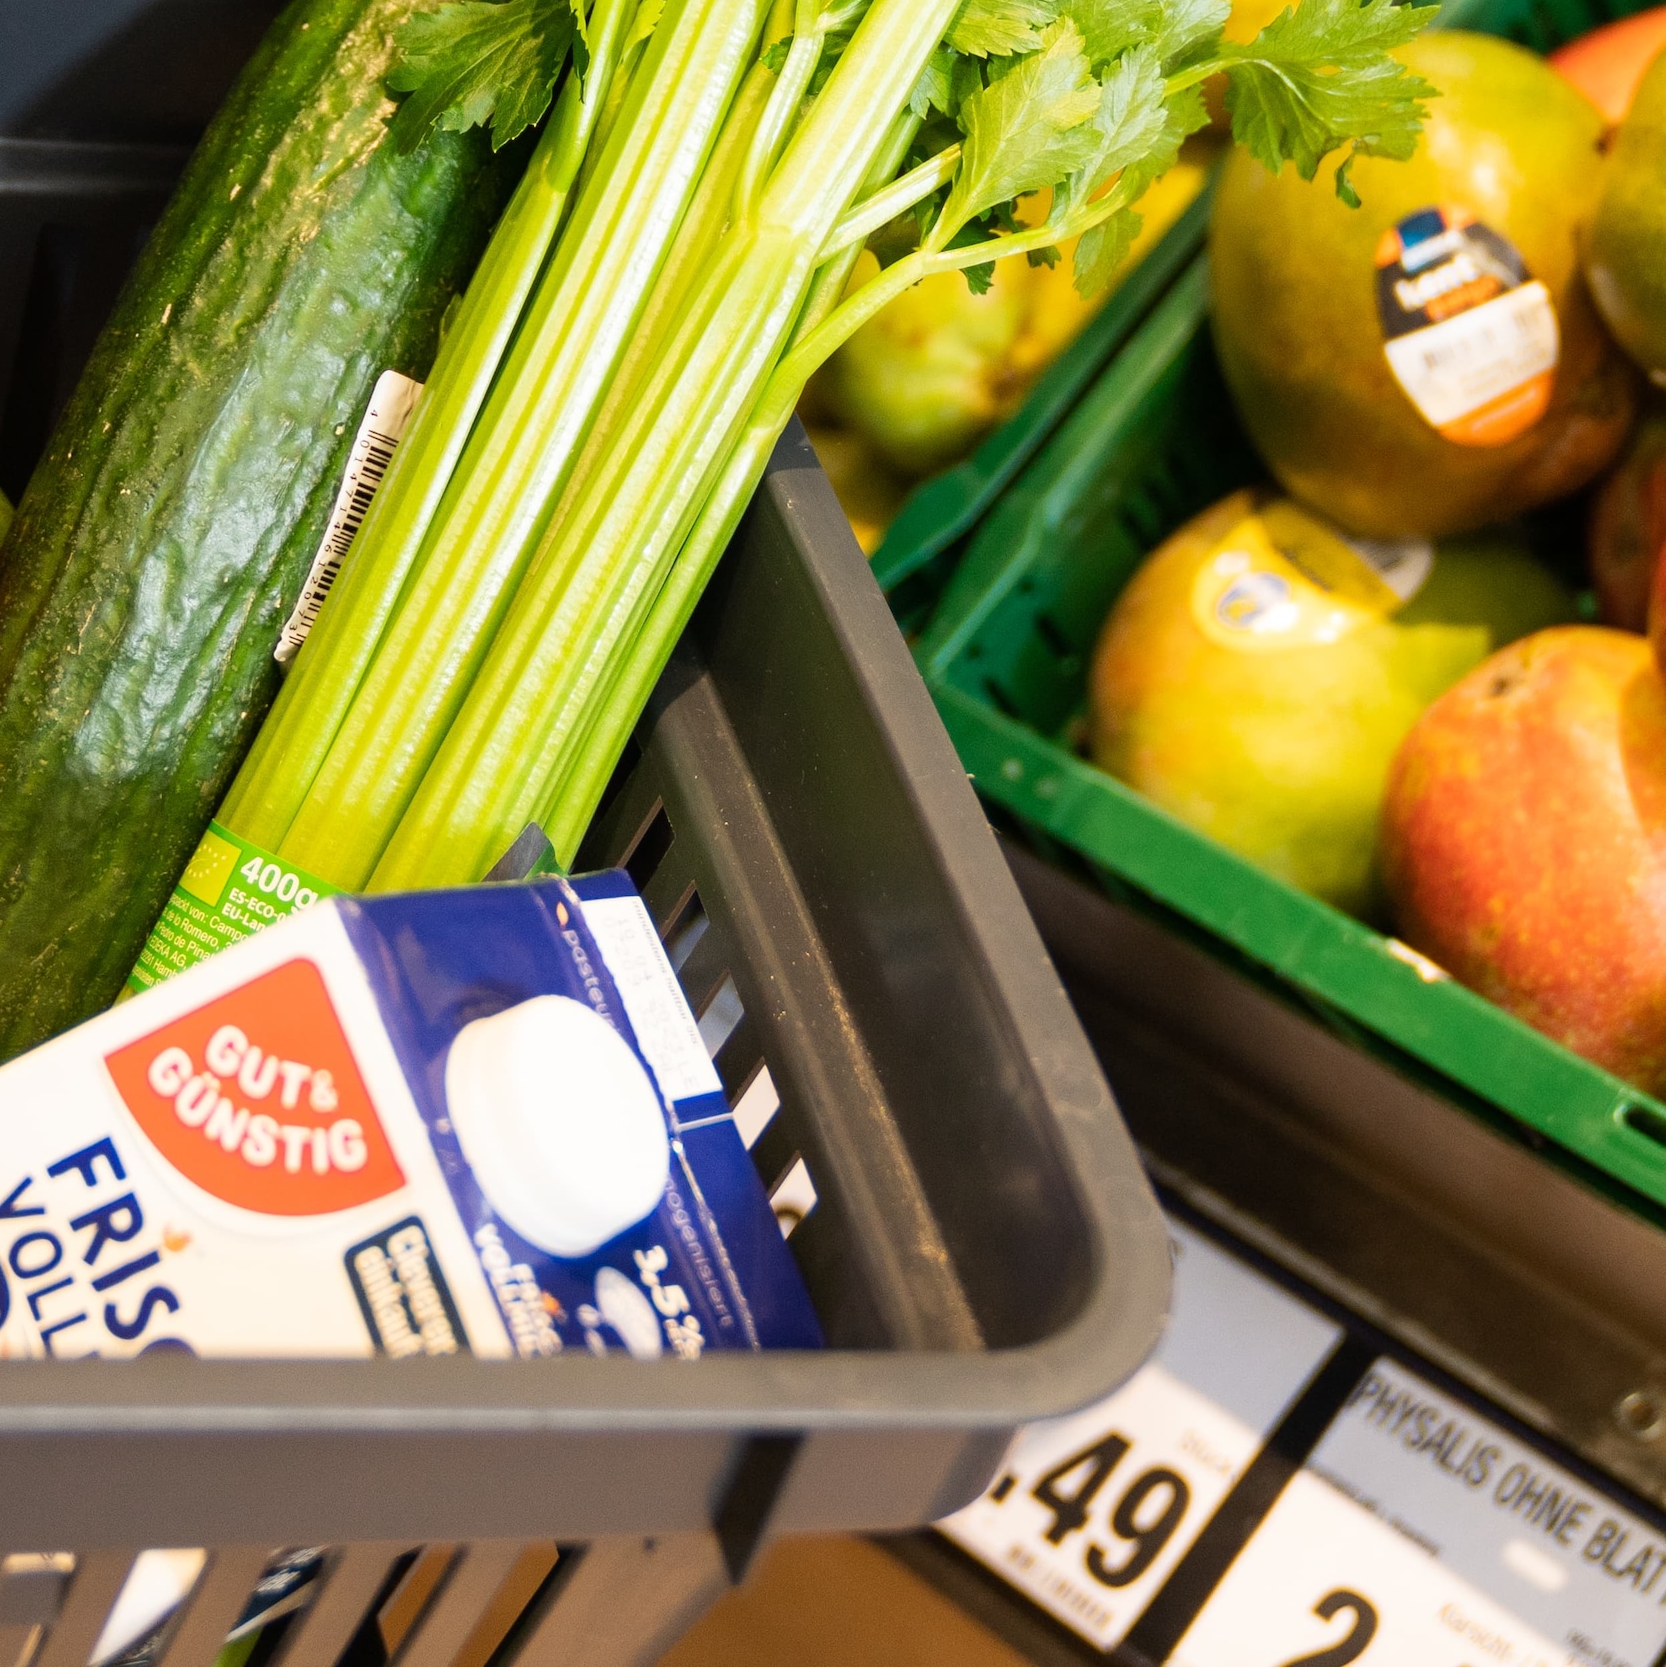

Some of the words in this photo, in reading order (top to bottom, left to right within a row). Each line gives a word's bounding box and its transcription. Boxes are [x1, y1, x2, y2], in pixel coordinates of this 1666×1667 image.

[228, 887, 287, 923] ES-ECO-0
[240, 856, 319, 915] 400g
[147, 1046, 369, 1176] GÜNSTIG
[205, 1024, 339, 1114] GUT&
[45, 1135, 201, 1360] FRIS
[989, 1429, 1192, 1589] .49
[1347, 1370, 1504, 1495] PHYSALIS
[1492, 1461, 1597, 1550] OHNE
